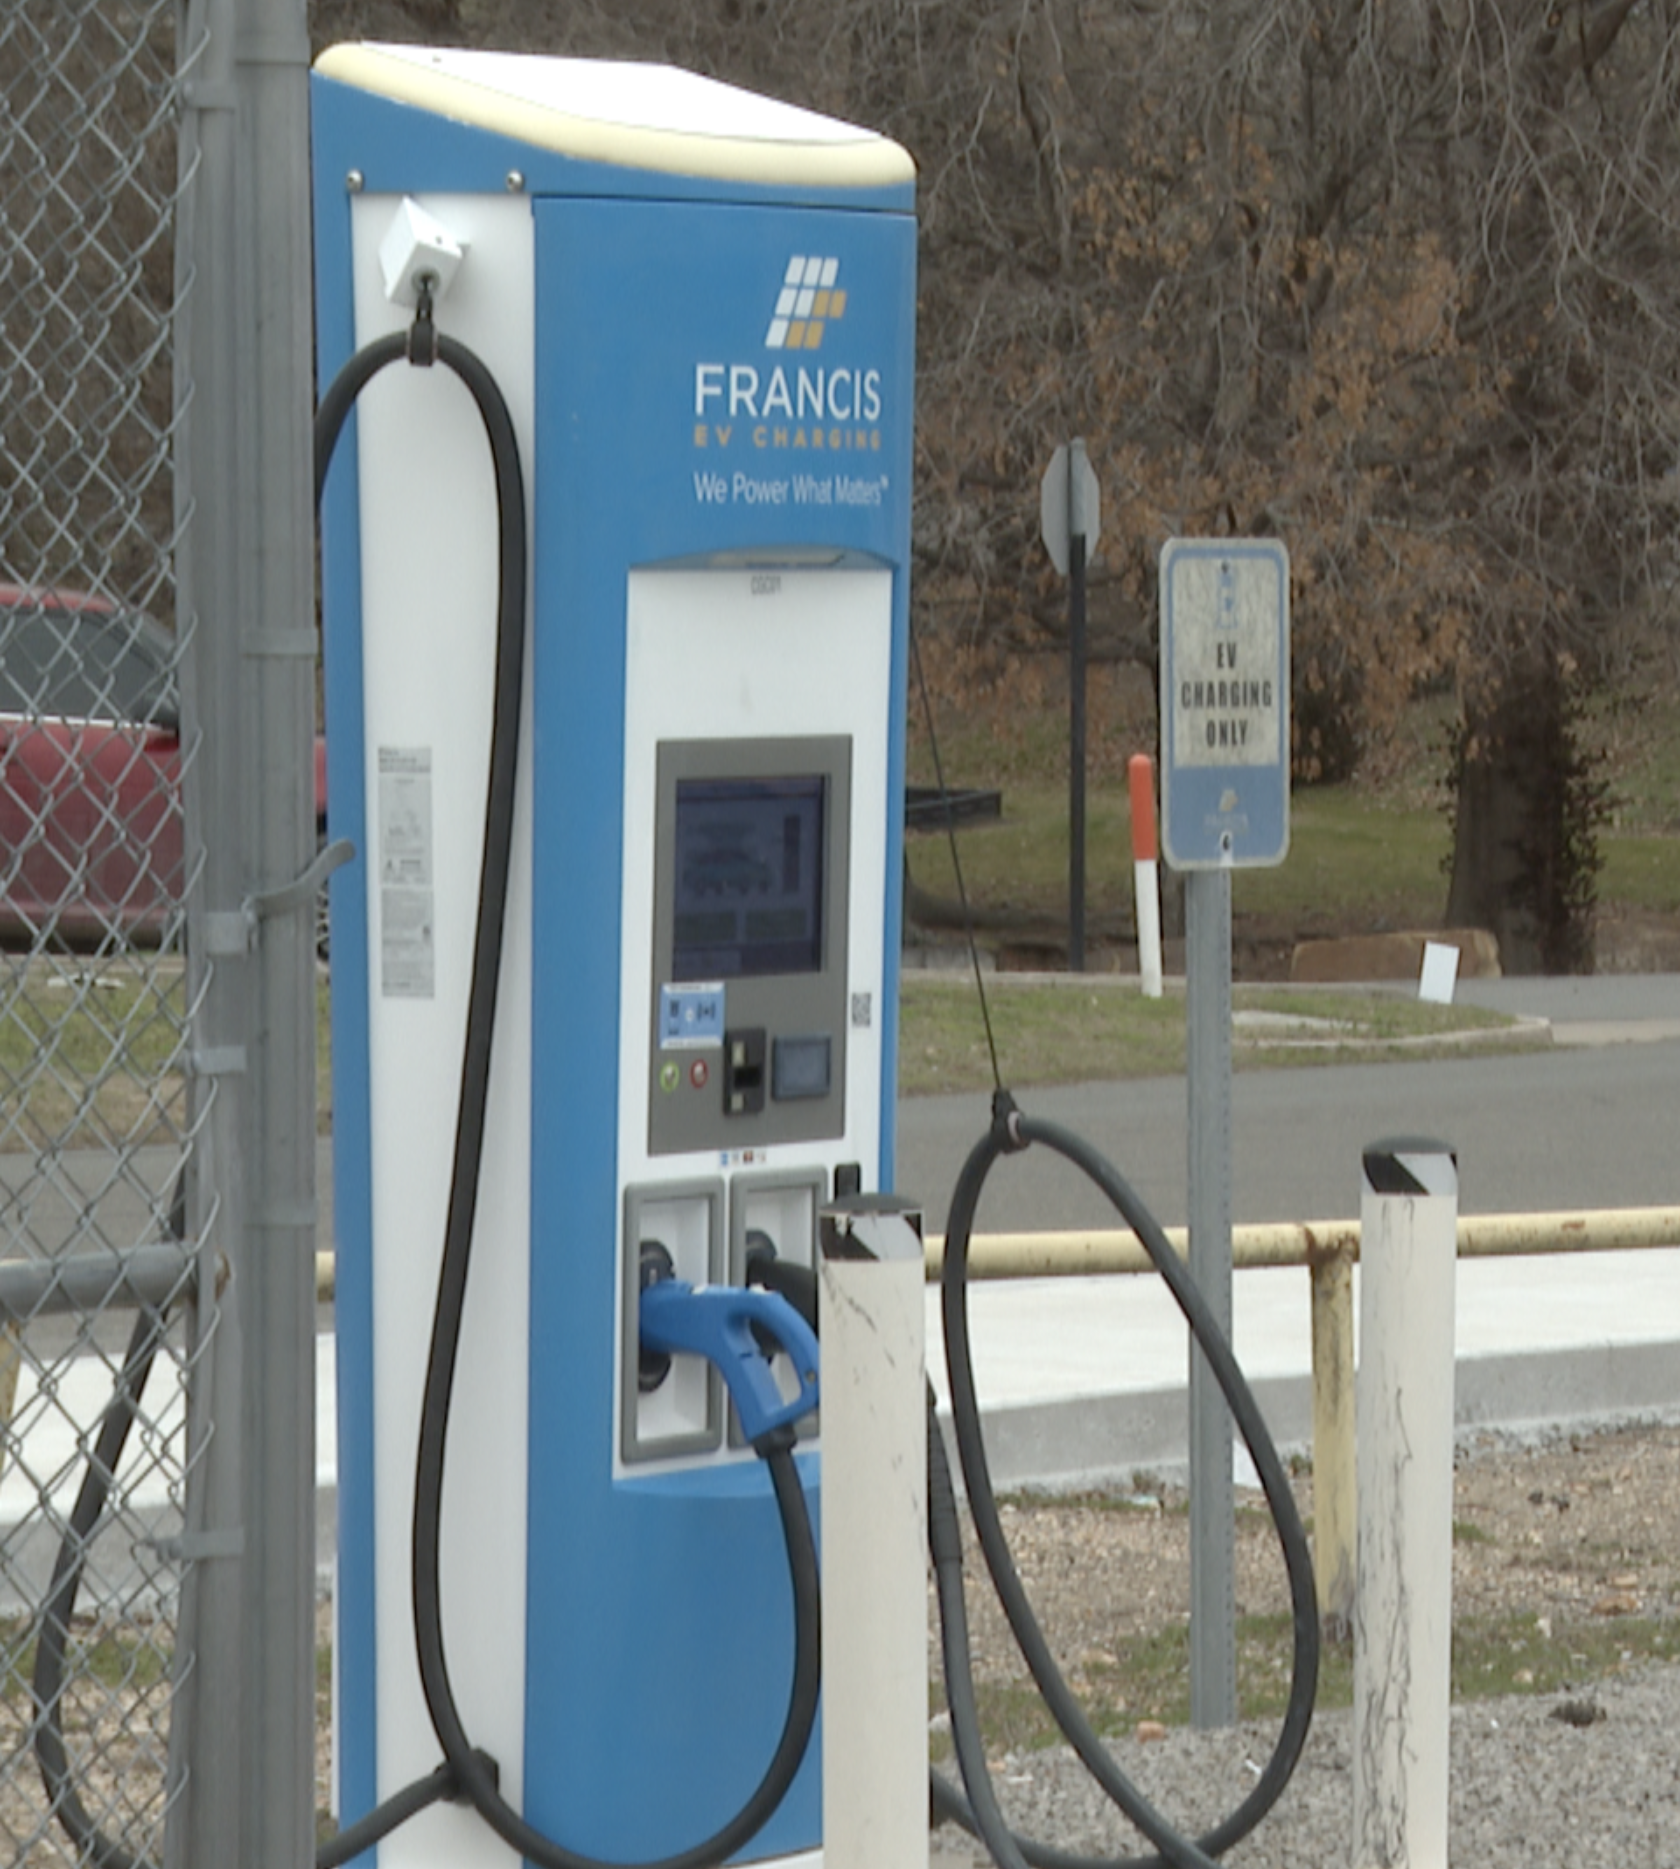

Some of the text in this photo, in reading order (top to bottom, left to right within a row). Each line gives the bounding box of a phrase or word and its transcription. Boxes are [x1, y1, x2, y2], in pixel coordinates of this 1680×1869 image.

[695, 363, 881, 421] FRANCIS
[694, 424, 881, 450] EV CHARGING
[694, 471, 727, 504] We
[732, 471, 788, 505] Power
[792, 474, 832, 505] What
[1216, 642, 1237, 670] EV
[1181, 680, 1273, 710] CHARGING
[1206, 719, 1249, 748] ONLY
